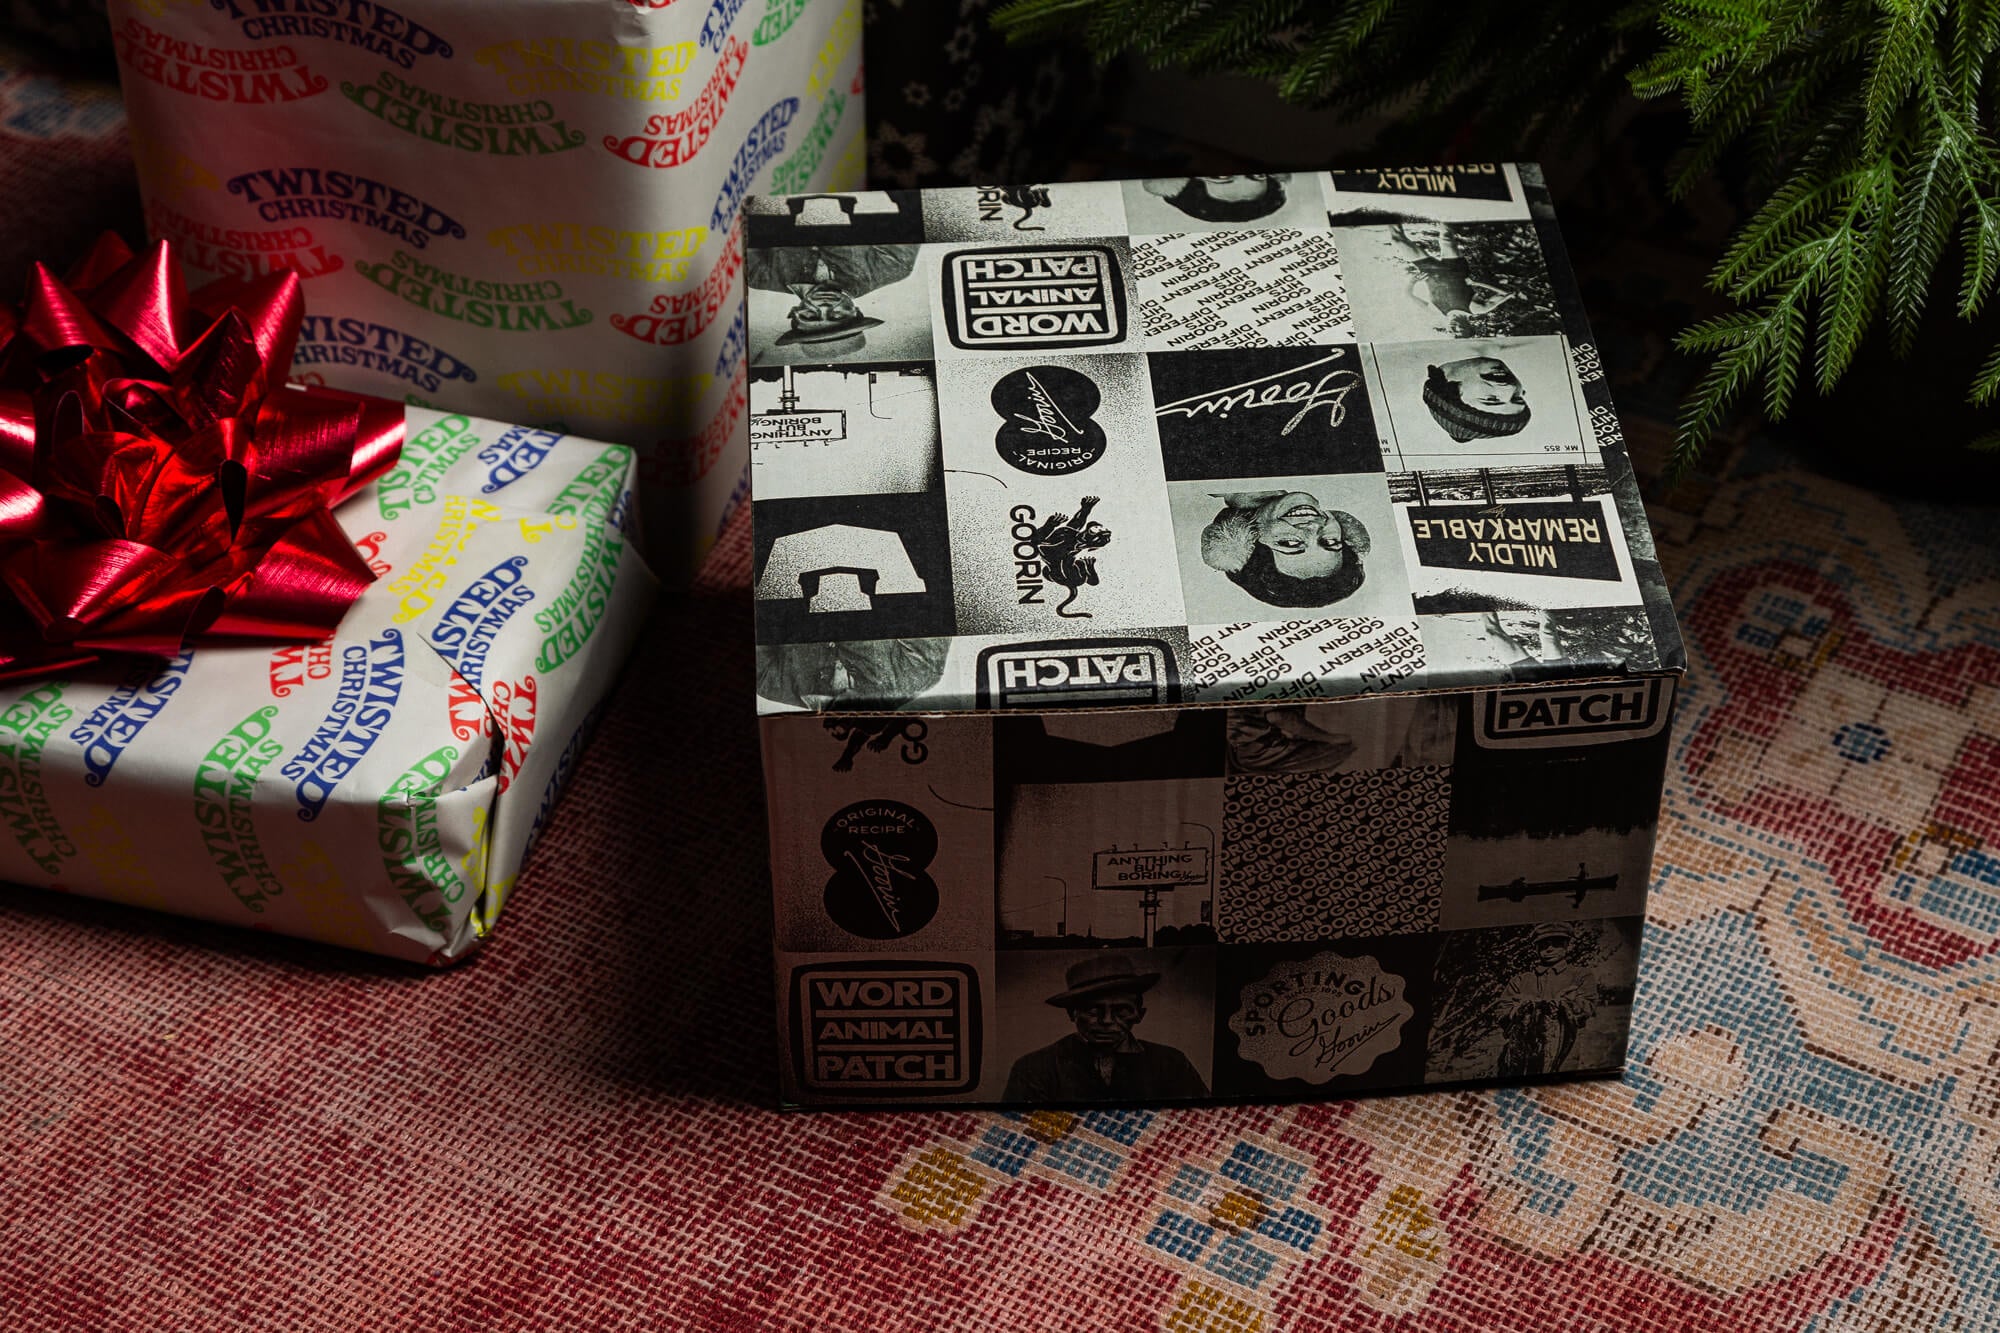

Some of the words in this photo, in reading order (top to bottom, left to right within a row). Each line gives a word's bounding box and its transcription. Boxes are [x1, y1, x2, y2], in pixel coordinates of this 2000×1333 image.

[242, 15, 417, 70] CHRISTMAS
[474, 38, 696, 77] TWISTED
[376, 71, 554, 125] CHRISTMAS
[507, 70, 682, 101] CHRISTMAS
[603, 40, 749, 169] TWISTED
[340, 81, 586, 156] TWISTED
[710, 97, 799, 231] TWISTED
[1376, 172, 1457, 193] MILDLY
[228, 167, 466, 240] TWISTED
[258, 199, 430, 249] CHRISTMAS
[487, 223, 707, 258] TWISTED
[1243, 230, 1303, 256] GOORIN
[1244, 235, 1324, 270] DIFFERENT
[1297, 241, 1332, 258] HITS
[517, 253, 691, 282] CHRISTMAS
[965, 256, 1098, 281] PATCH
[1179, 255, 1214, 272] HITS
[1279, 247, 1338, 274] GOORIN
[392, 250, 562, 302] CHRISTMAS
[1160, 262, 1220, 288] GOORIN
[1161, 267, 1241, 303] DIFFERENT
[1214, 273, 1250, 290] HITS
[1269, 280, 1304, 297] HITS
[356, 260, 593, 331] TWISTED
[969, 287, 1100, 306] ANIMAL
[1197, 280, 1257, 306] GOORIN
[1216, 274, 1296, 310] DIFFERENT
[1251, 287, 1311, 314] GOORIN
[1309, 296, 1344, 314] HITS
[1186, 313, 1221, 330] HITS
[1255, 290, 1336, 327] DIFFERENT
[1291, 303, 1350, 331] GOORIN
[971, 312, 1105, 337] WORD
[1167, 320, 1227, 347] GOORIN
[293, 344, 440, 393] HRISTMAS
[497, 369, 712, 405] TWISTED
[751, 429, 832, 440] ANYTHING
[760, 417, 821, 427] BORING
[776, 424, 806, 432] BUT
[1016, 452, 1094, 470] ORIGINAL
[1026, 447, 1081, 456] RECIPE
[1413, 518, 1601, 544] REMARKABLE
[1009, 504, 1045, 606] GOORIN
[1467, 542, 1558, 569] MILDLY
[1318, 620, 1384, 654] GOORIN
[1379, 635, 1418, 657] HITS
[1319, 627, 1409, 676] DIFFERENT
[1359, 644, 1424, 683] GOORIN
[1002, 654, 1154, 689] PATCH
[1245, 654, 1285, 677] HITS
[280, 645, 367, 781] CHRISTMAS
[1499, 692, 1643, 729] PATCH
[296, 628, 404, 822] TWISTED
[194, 705, 278, 913] TWISTED
[229, 739, 283, 896] CHRISTMAS
[836, 807, 917, 829] ORIGINAL
[848, 825, 906, 835] RECIPE
[1107, 854, 1193, 866] ANYTHING
[1134, 863, 1166, 873] BUT
[1118, 870, 1181, 881] BORING
[815, 981, 954, 1007] WORD
[1245, 971, 1365, 1036] SPORTING
[1270, 975, 1395, 1056] Goods
[818, 1020, 954, 1041] ANIMAL
[817, 1055, 955, 1080] PATCH
